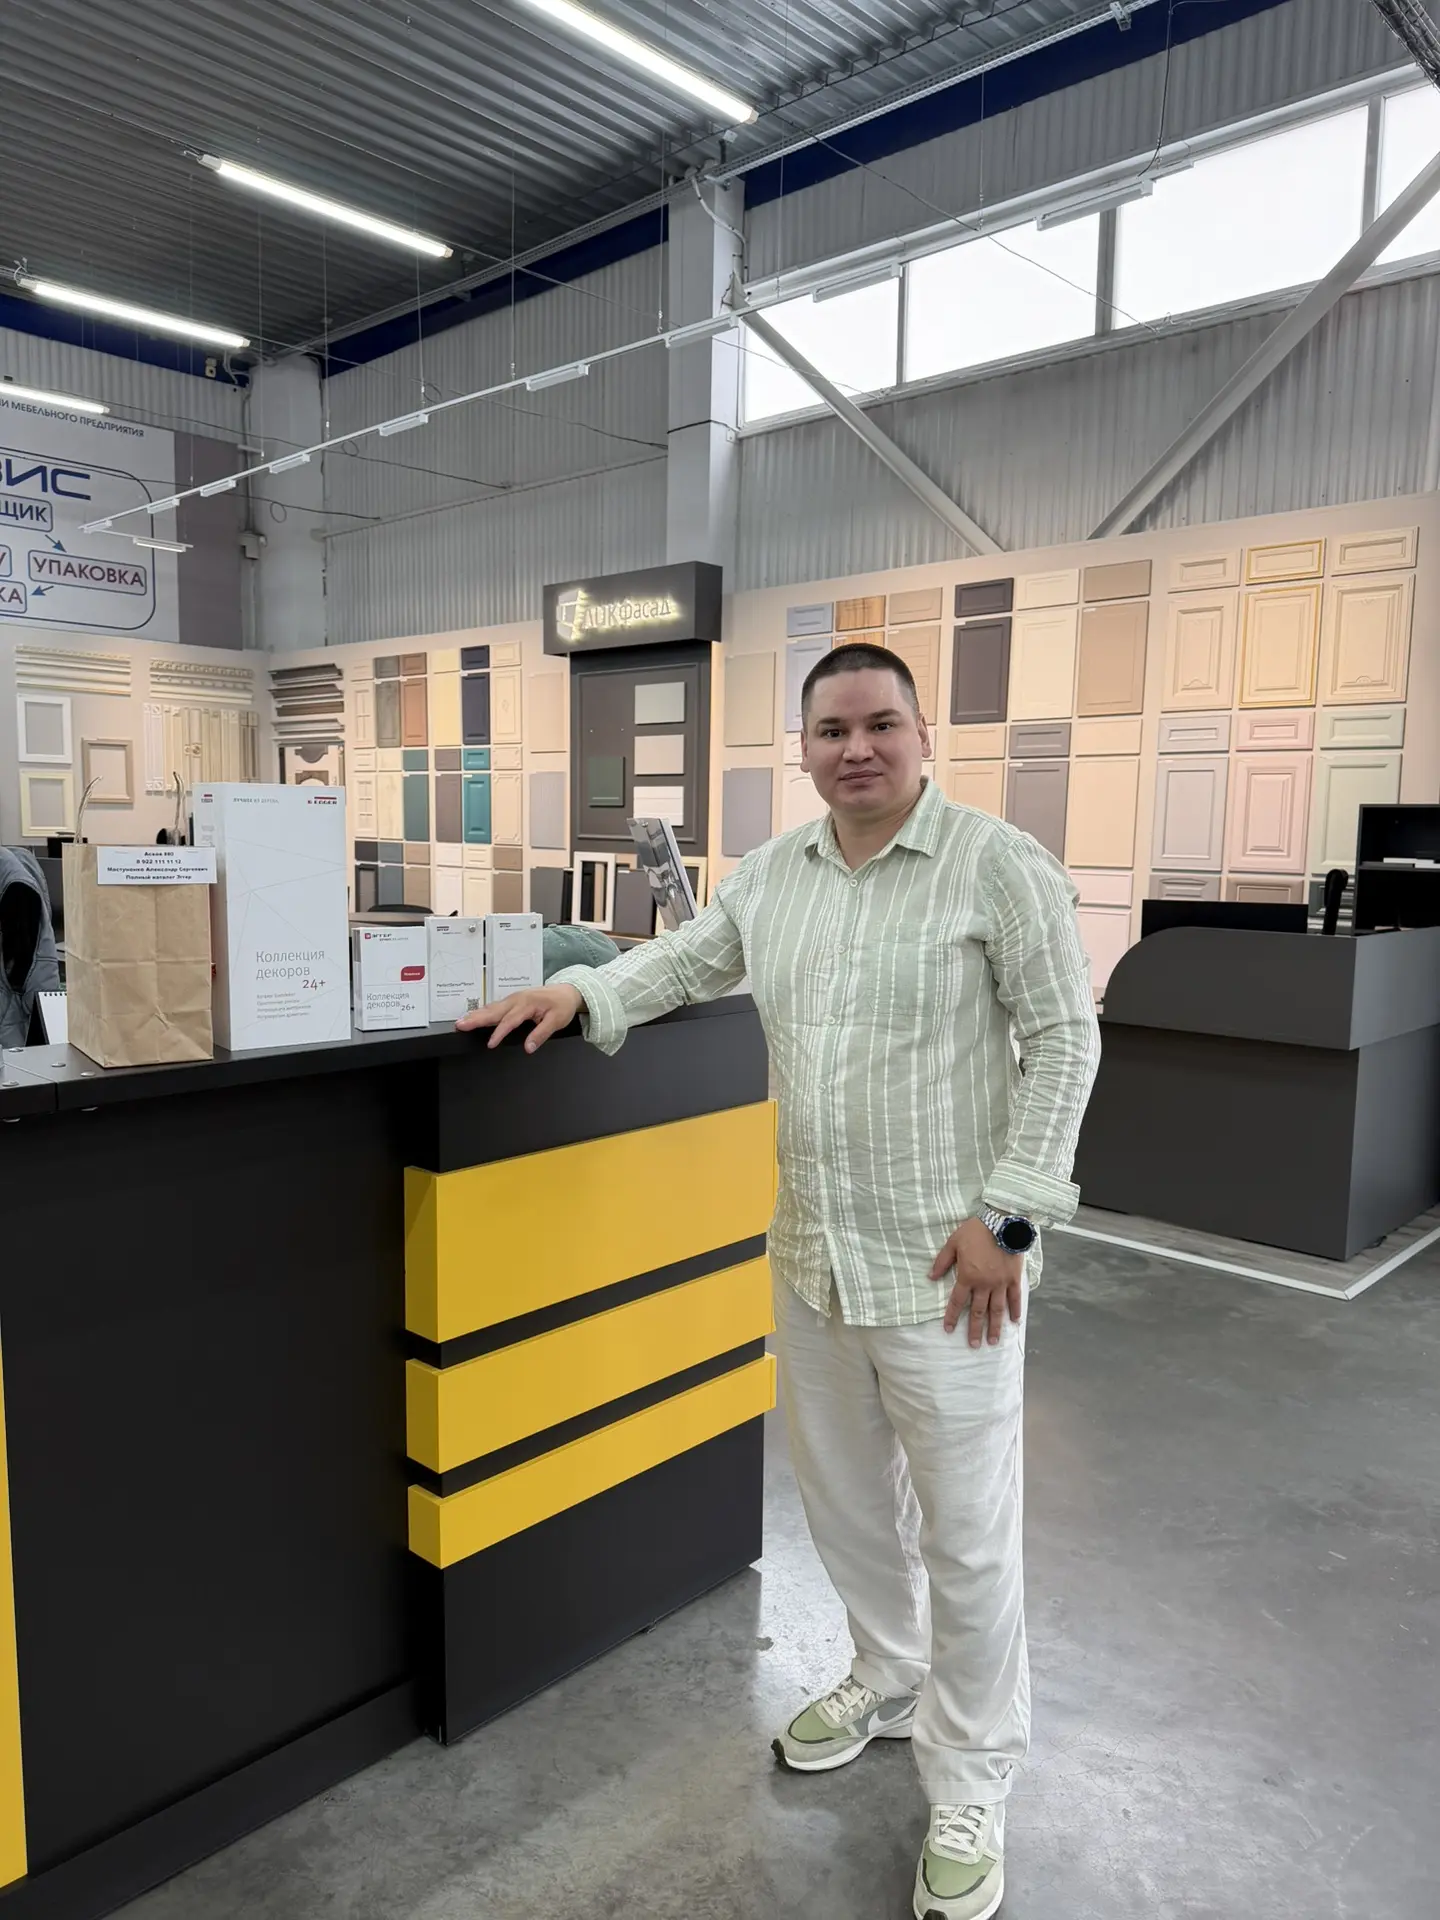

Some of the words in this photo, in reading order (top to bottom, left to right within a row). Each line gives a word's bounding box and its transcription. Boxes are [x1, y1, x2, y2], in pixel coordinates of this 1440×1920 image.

[11, 400, 78, 423] МЕБЕЛЬНОГО
[79, 417, 145, 437] ПРЕДПРИЯТИЯ
[0, 458, 91, 501] ИС
[33, 556, 145, 588] УПАКОВКА
[256, 951, 325, 963] Коллекция
[256, 966, 310, 980] декоров
[302, 979, 326, 990] 24+
[366, 992, 410, 1001] Коллекция
[366, 1001, 401, 1010] декоров
[401, 1003, 416, 1011] 26+
